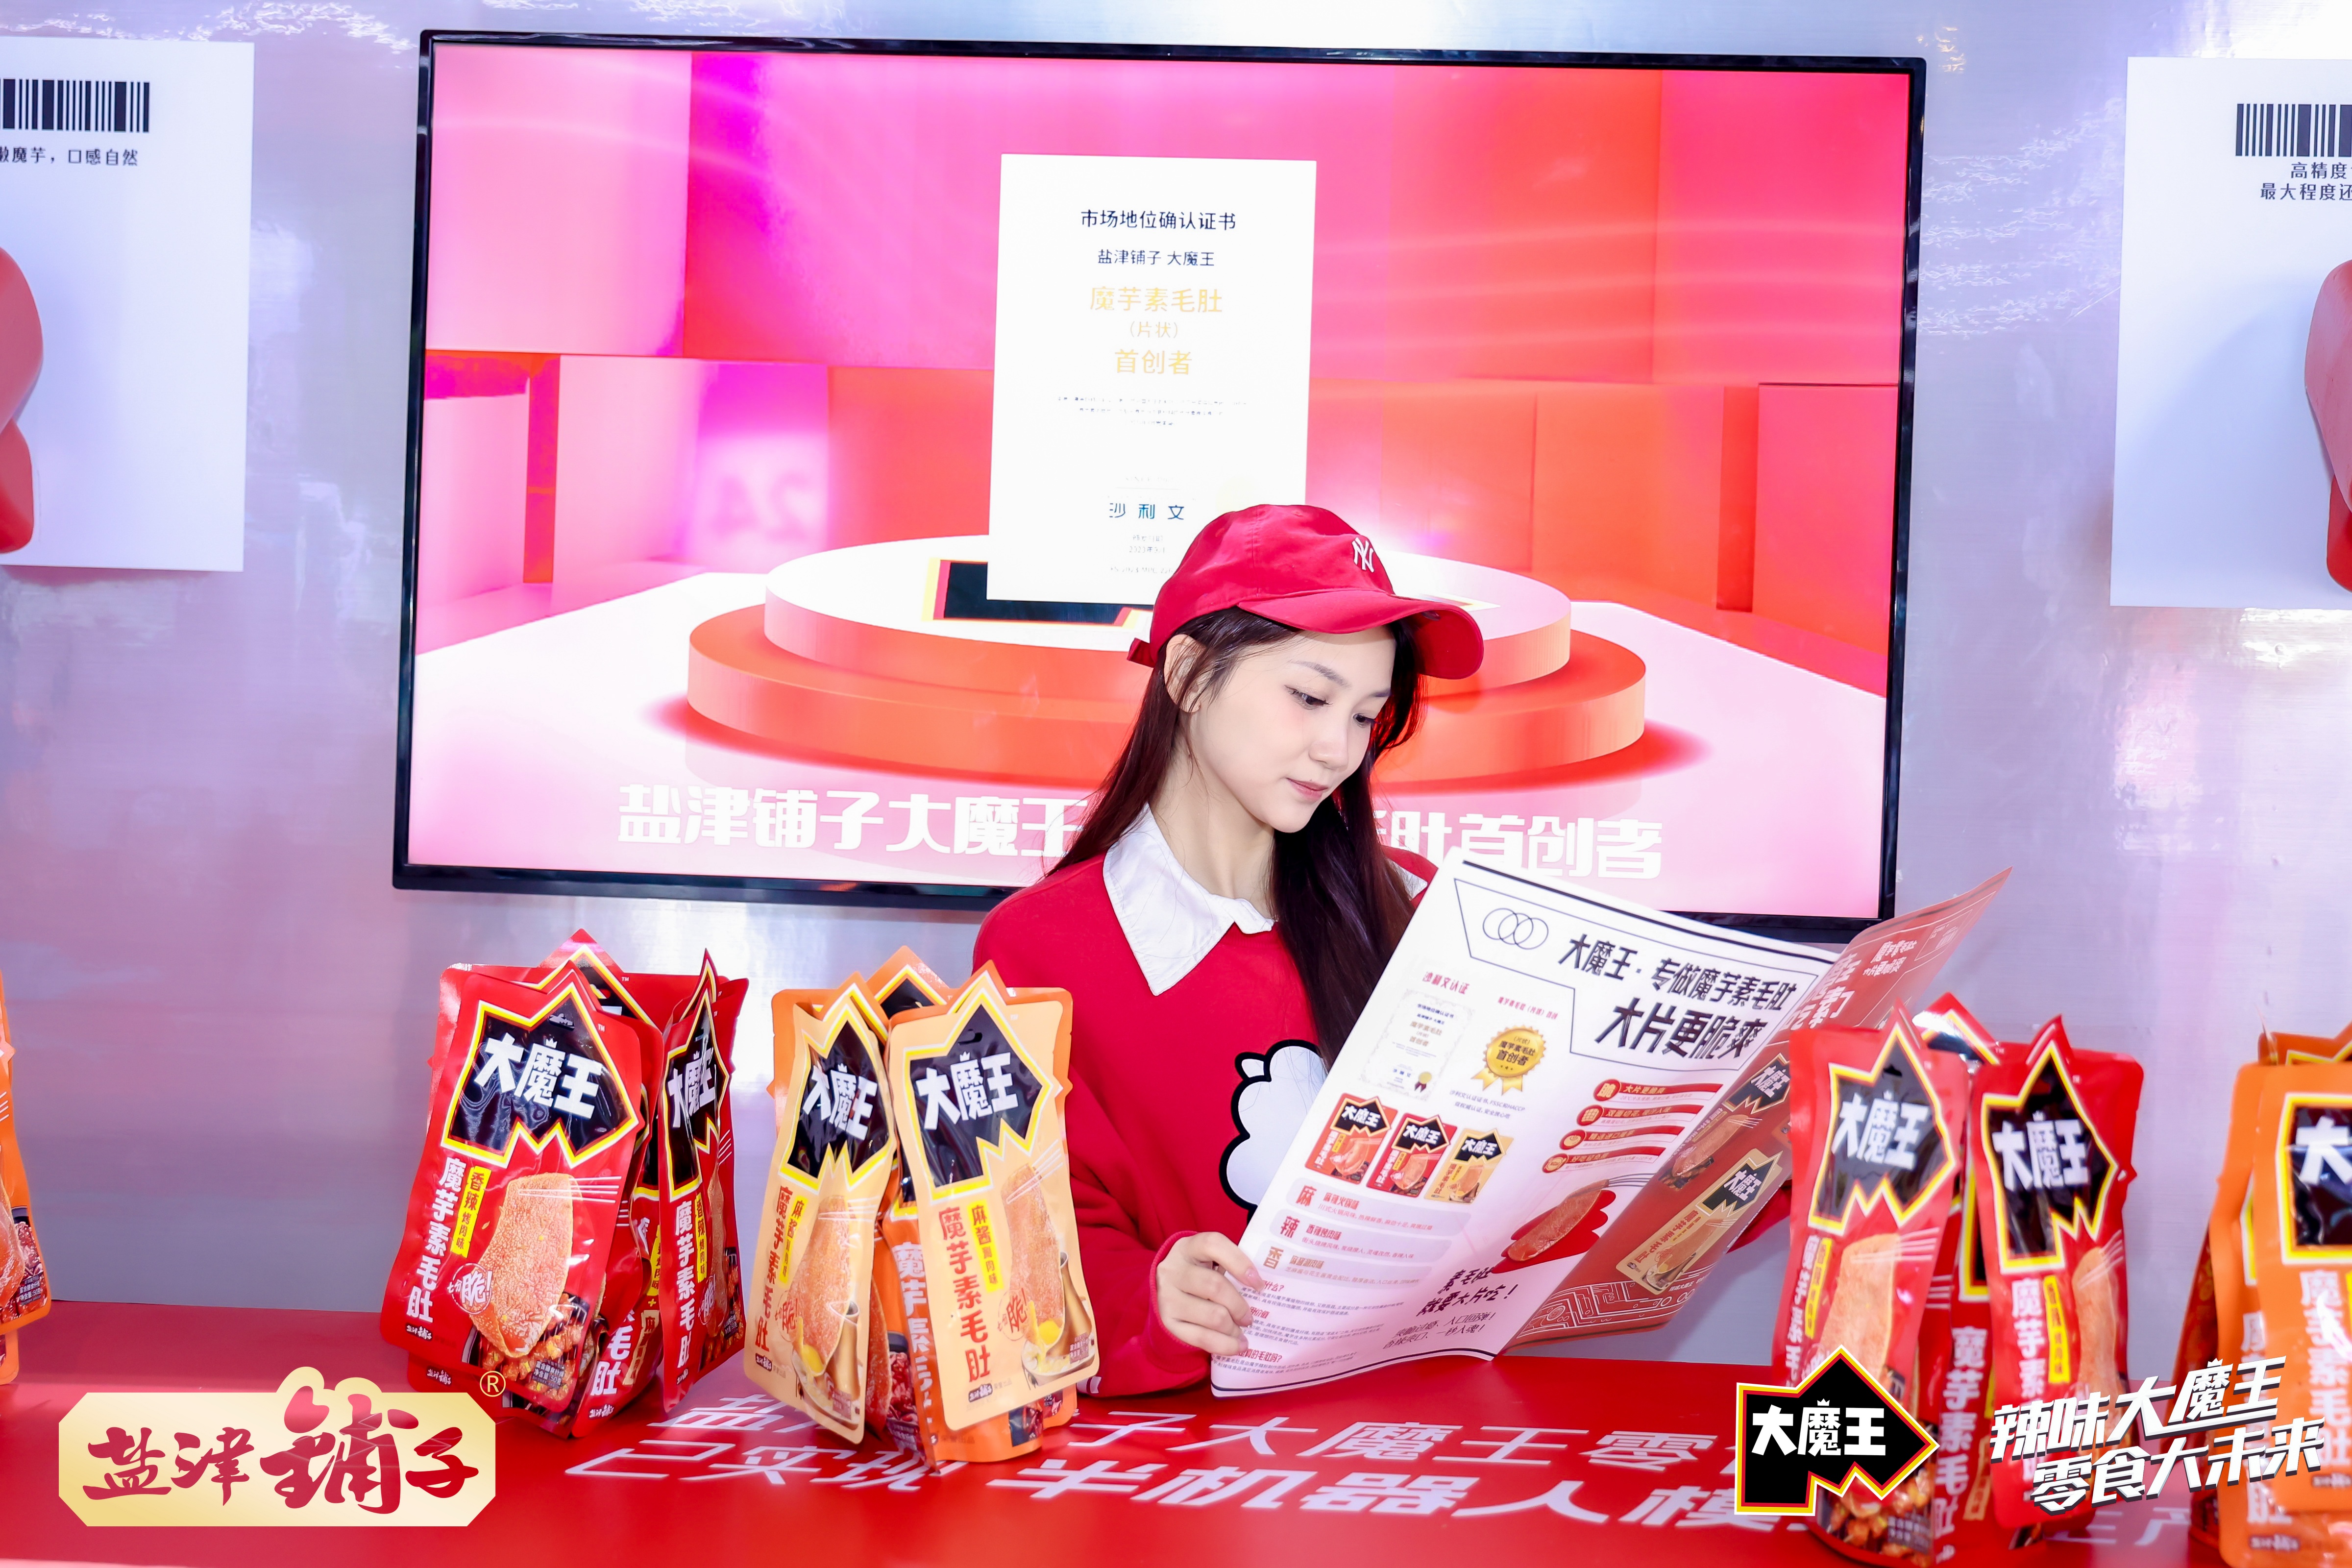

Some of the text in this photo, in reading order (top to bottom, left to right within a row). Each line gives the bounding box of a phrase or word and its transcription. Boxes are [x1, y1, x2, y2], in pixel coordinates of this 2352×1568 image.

[1081, 209, 1236, 231] 市场地位确认证书
[1098, 249, 1215, 266] 盐津铺子 大魔王
[1090, 286, 1223, 313] 魔芋素毛肚
[1114, 348, 1192, 375] 首创者
[1108, 502, 1185, 520] 沙利文
[1373, 810, 1663, 880] 肚首创者
[1422, 971, 1470, 995] 沙利文认证
[1495, 1050, 1529, 1066] 首创者
[1595, 997, 1769, 1060] 大片更脆爽
[473, 1032, 603, 1119] 大魔王
[667, 1047, 716, 1128] 大魔王
[802, 1064, 878, 1140] 大魔王
[915, 1052, 1019, 1130] 大魔王
[1751, 1065, 1790, 1098] 大魔王
[1341, 1104, 1381, 1127] 大魔王
[1402, 1124, 1442, 1145] 大魔王
[1461, 1137, 1498, 1156] 大魔王
[1831, 1092, 1934, 1171] 大魔王
[1992, 1110, 2089, 1193] 大魔王
[455, 1172, 486, 1250] 香辣烤肉味
[1296, 1184, 1317, 1207] 麻
[1724, 1168, 1762, 1201] 大魔王
[406, 1156, 467, 1323] 魔芋素毛肚
[695, 1199, 707, 1276] 香辣烤肉味
[1263, 1246, 1284, 1270] 香
[1279, 1215, 1300, 1239] 辣
[675, 1200, 695, 1369] 魔芋素毛肚
[755, 1185, 793, 1352] 魔芋素毛肚
[938, 1206, 991, 1383] 魔芋素毛肚
[1786, 1235, 1820, 1387] 魔芋素毛
[1934, 1326, 1987, 1539] 魔芋素毛肚
